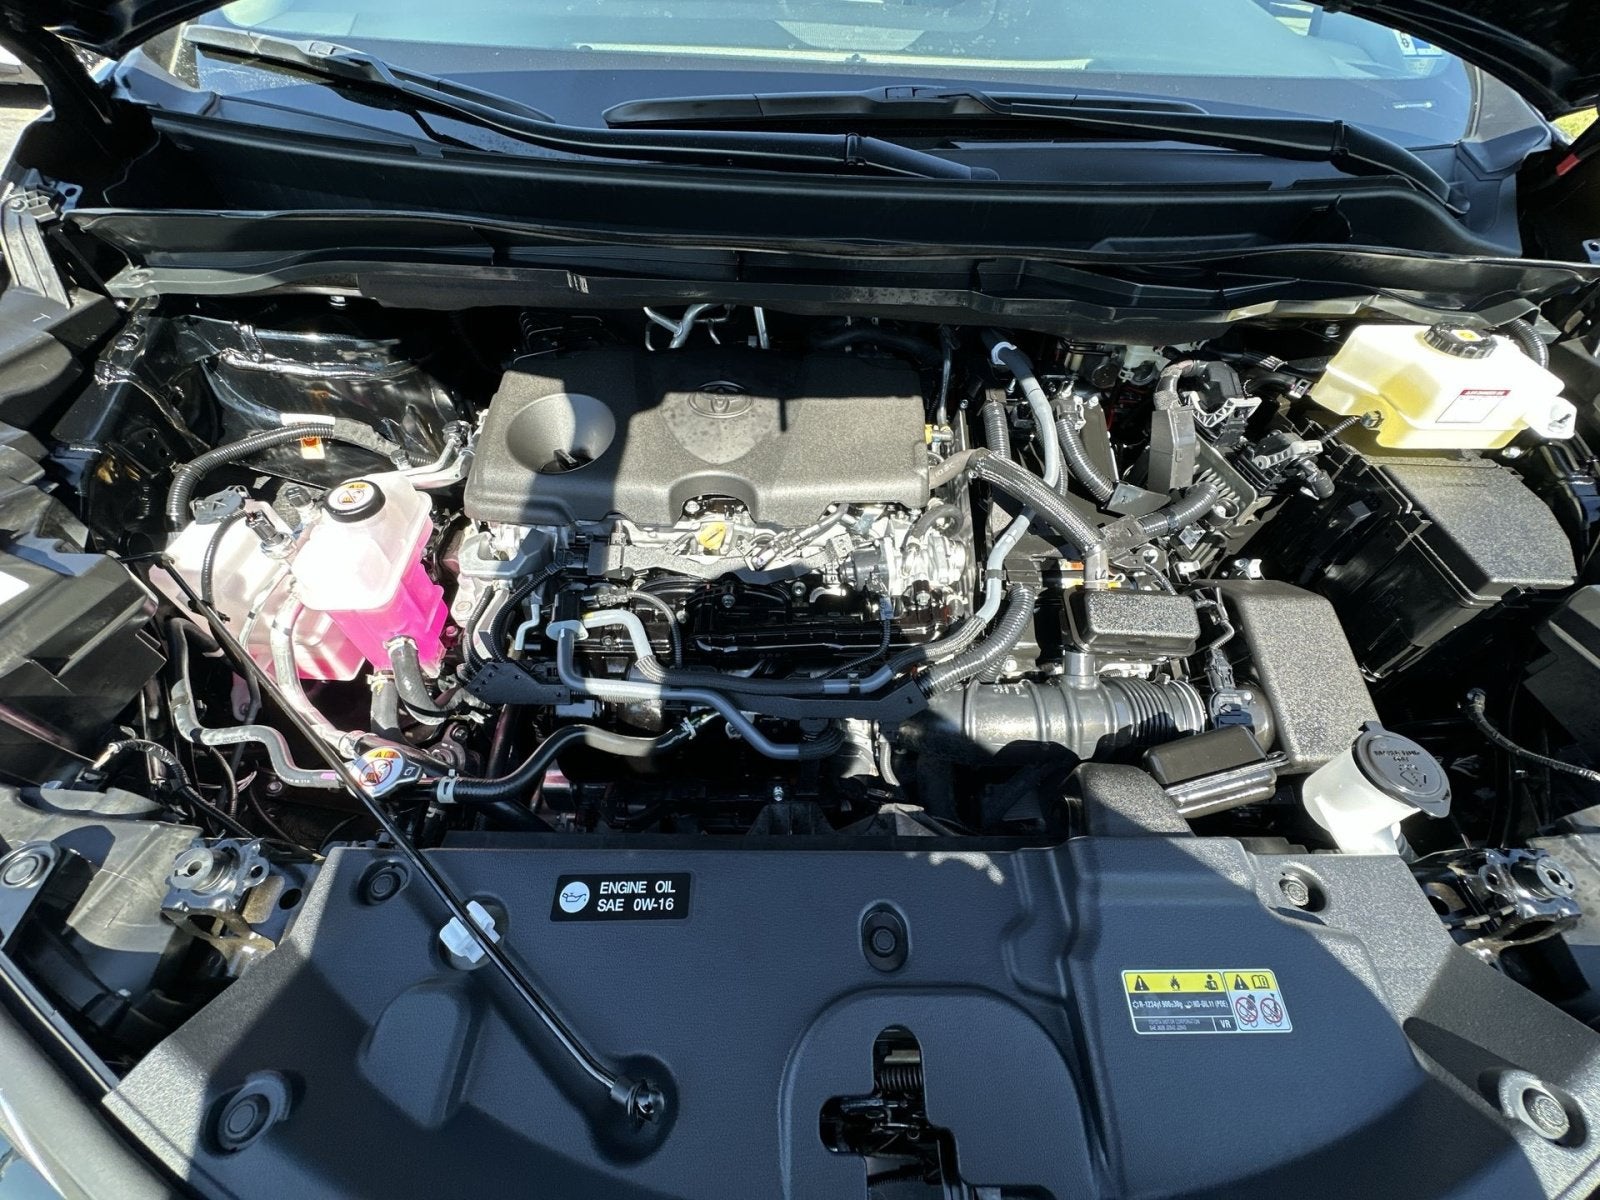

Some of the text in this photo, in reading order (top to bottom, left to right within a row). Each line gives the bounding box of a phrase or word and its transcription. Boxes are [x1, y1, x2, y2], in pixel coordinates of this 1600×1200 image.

[600, 881, 676, 894] ENGINE OIL
[597, 898, 674, 912] SAE 0W-16
[1220, 1019, 1232, 1029] VR
